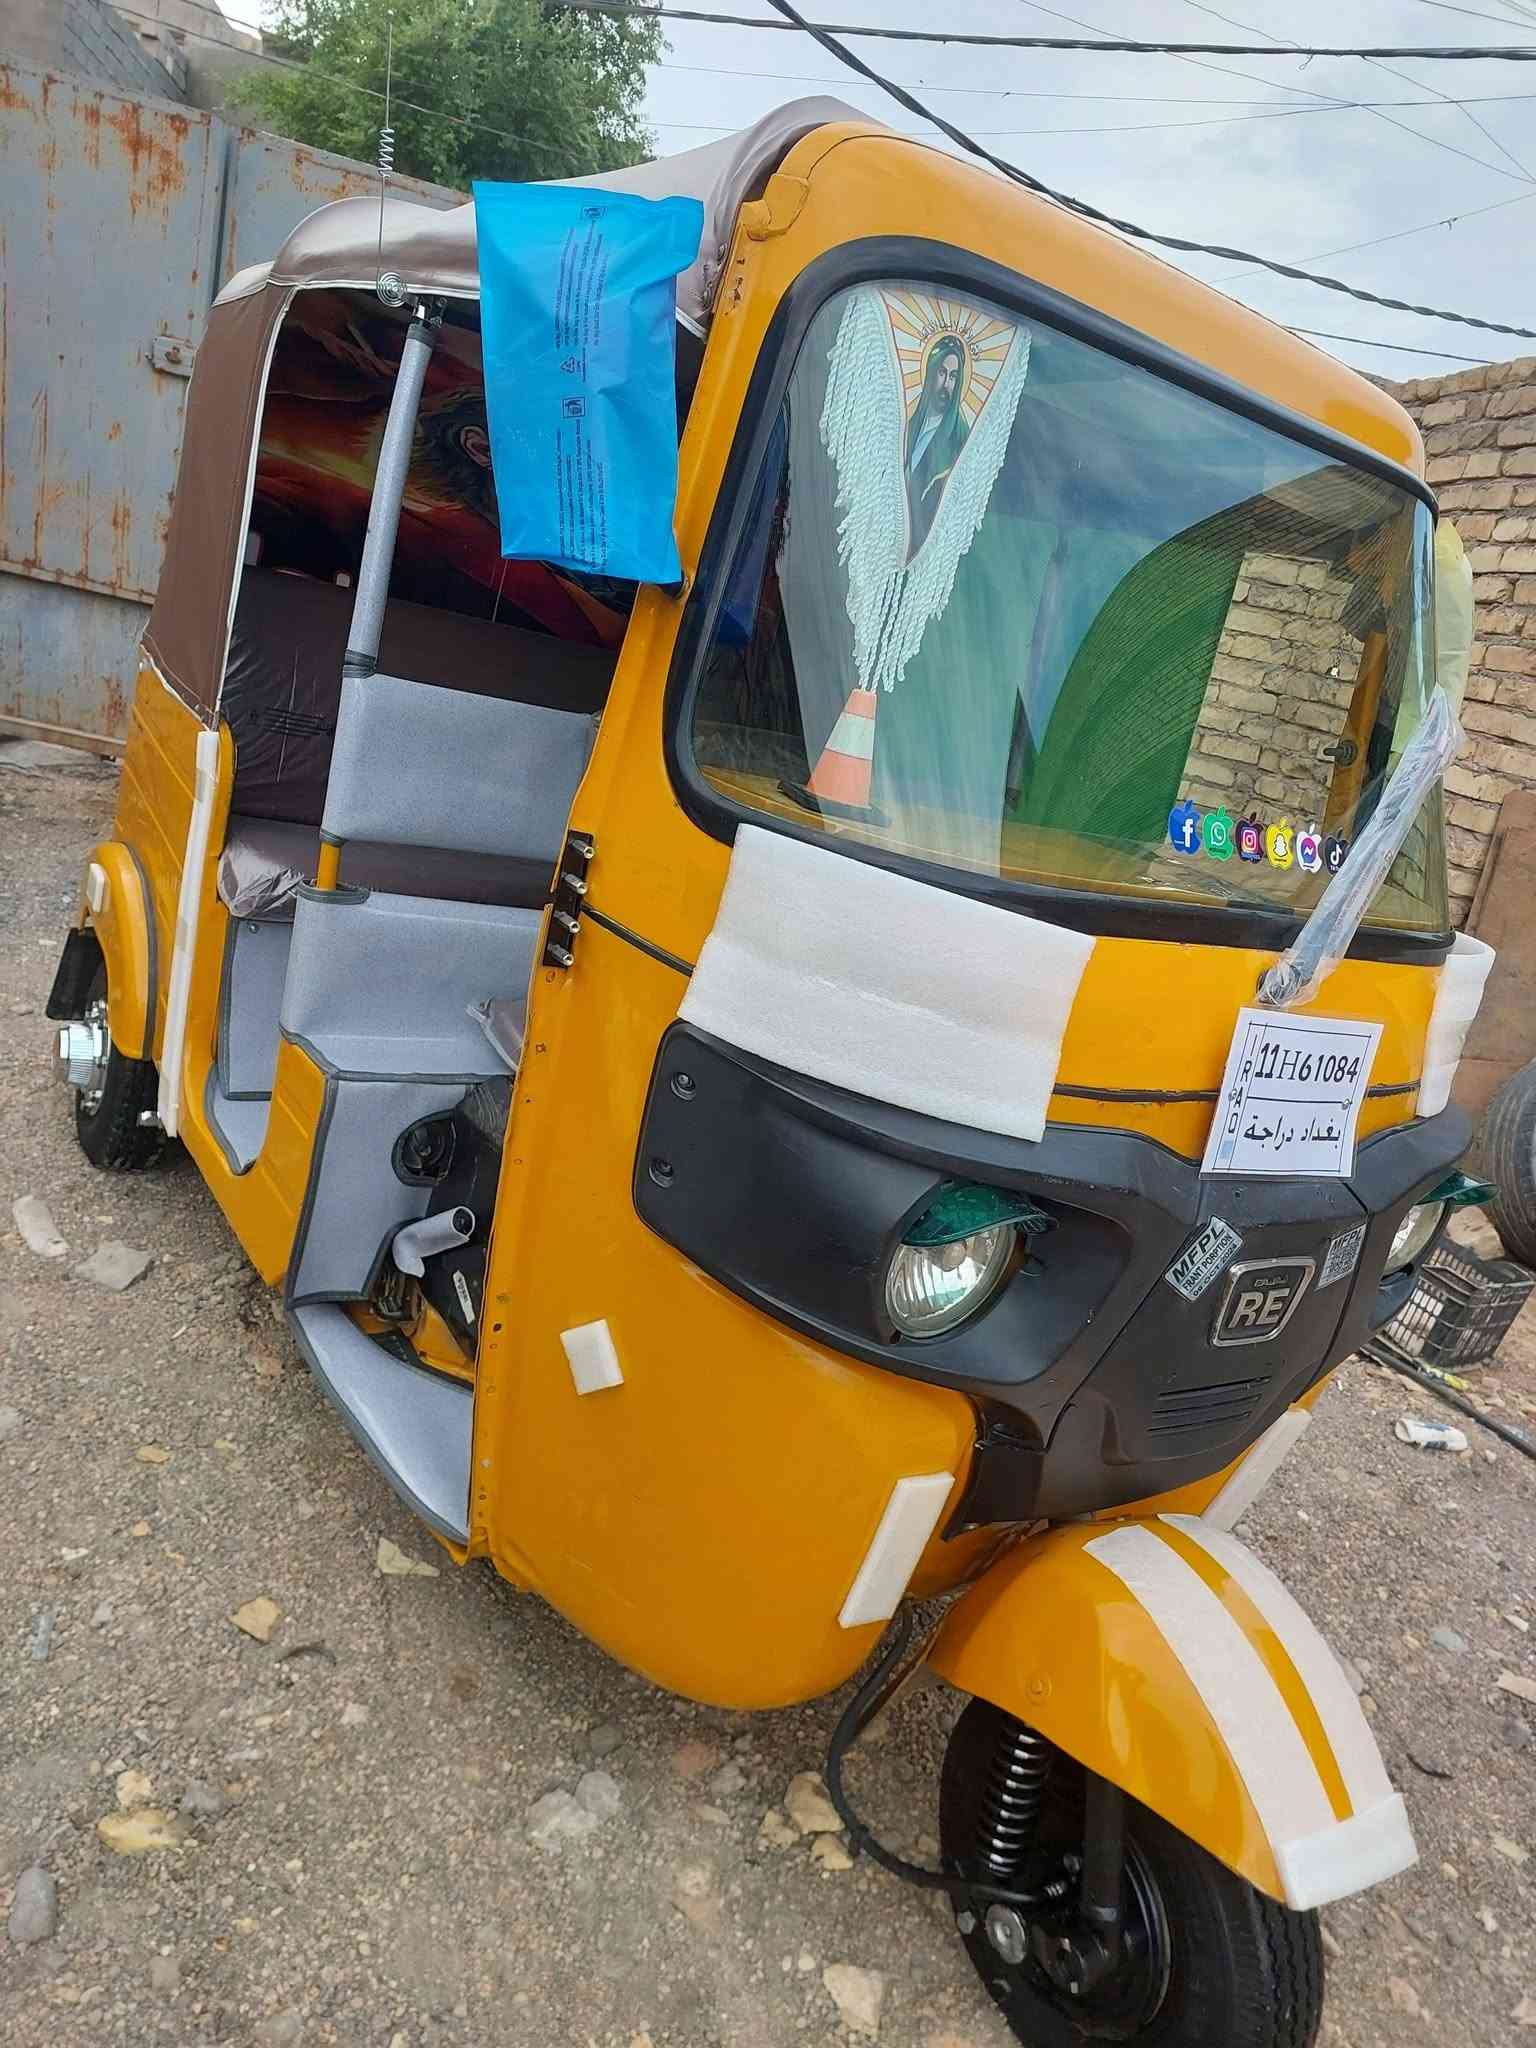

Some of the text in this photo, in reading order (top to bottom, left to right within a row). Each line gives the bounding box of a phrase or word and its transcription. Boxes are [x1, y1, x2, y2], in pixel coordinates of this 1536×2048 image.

[1254, 1042, 1361, 1083] 11H61084
[1243, 1114, 1341, 1151] بغداد دراجة
[1171, 1225, 1225, 1284] MFPL
[1227, 1287, 1292, 1329] RE
